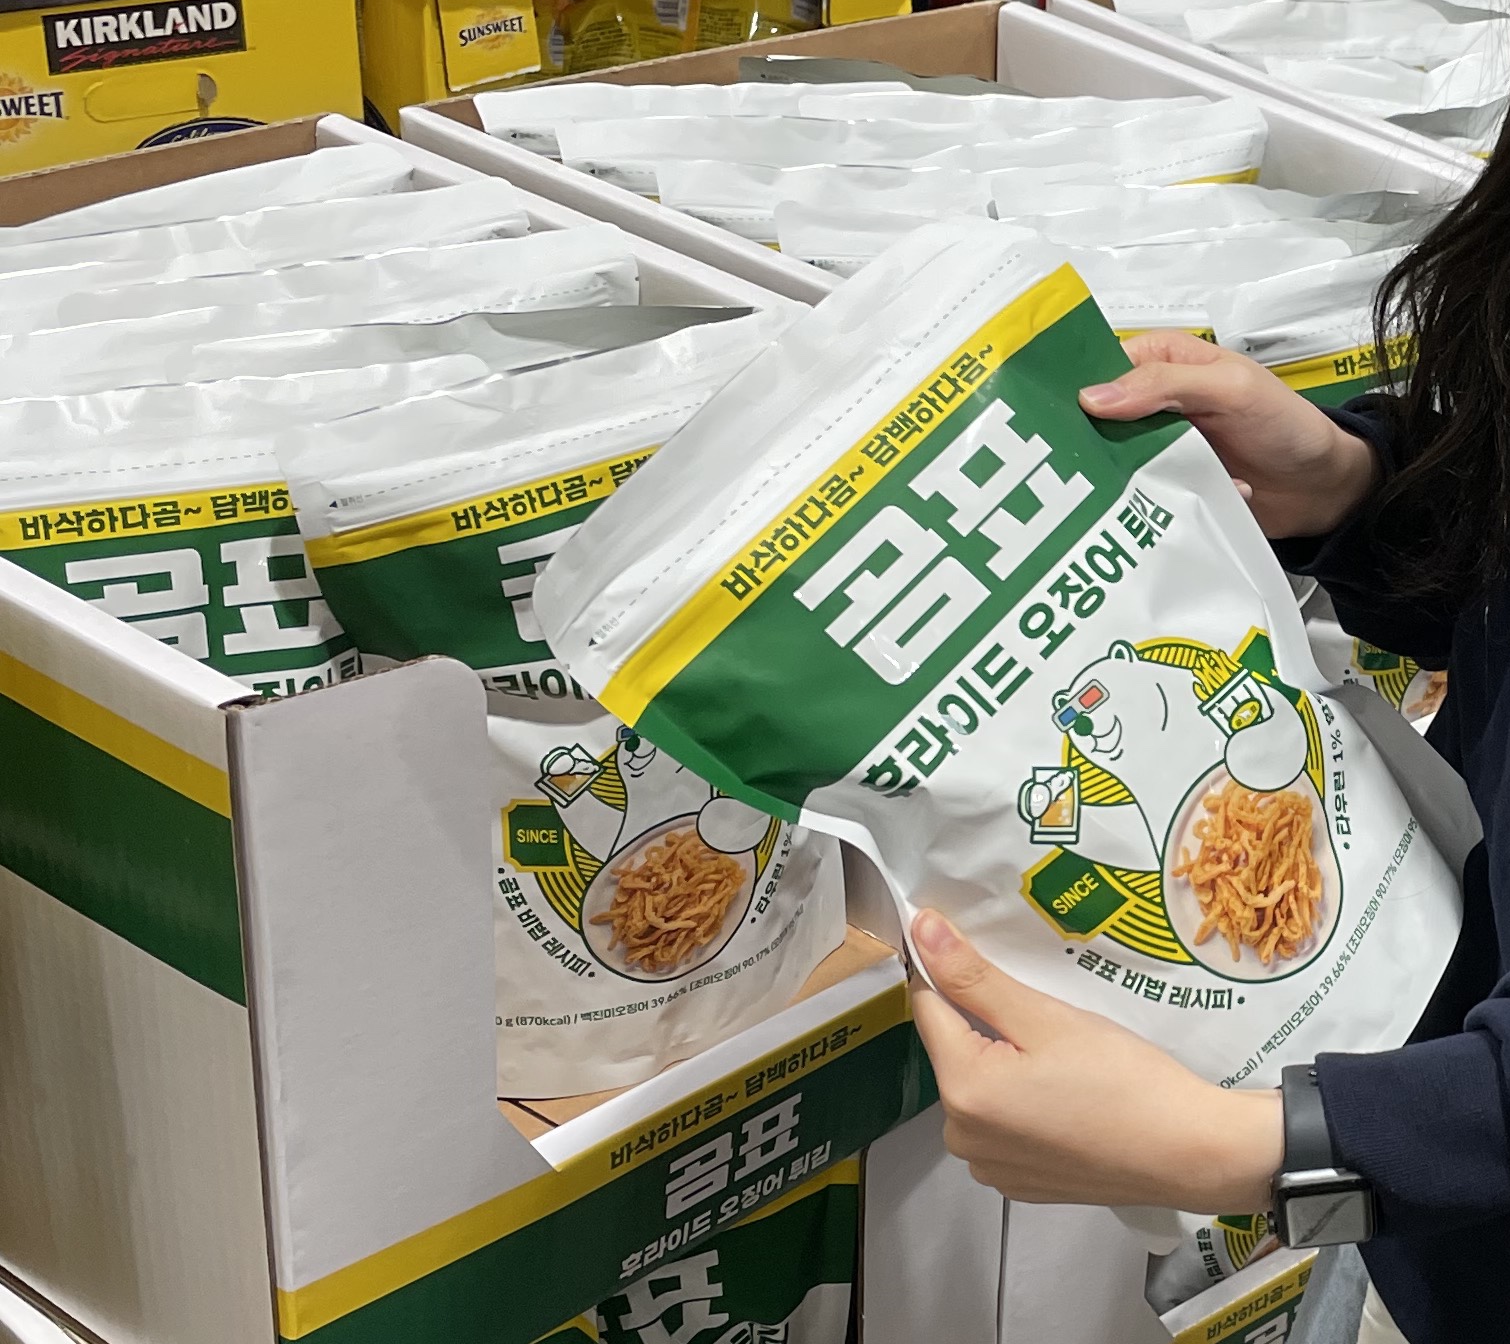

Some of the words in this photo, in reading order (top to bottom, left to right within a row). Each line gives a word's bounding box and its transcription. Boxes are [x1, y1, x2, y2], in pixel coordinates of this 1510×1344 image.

[55, 2, 237, 49] KIRKLAND
[459, 16, 525, 47] SUNSWEET
[451, 474, 603, 533] 바삭하다곰~
[720, 464, 866, 602] 바삭하다곰~
[860, 342, 996, 466] 담백하다곰~
[19, 497, 203, 543] 바삭하다곰~
[792, 396, 1096, 687] 곰표
[64, 534, 346, 660] 곰표
[1017, 527, 1139, 662] 오징어
[516, 827, 559, 844] SINCE
[1332, 770, 1353, 836] 타우린
[497, 876, 529, 914] 곰표
[516, 907, 552, 944] 비법
[541, 935, 592, 978] 레시피
[1051, 871, 1100, 918] SINCE
[1078, 947, 1121, 985] 곰표
[1120, 968, 1167, 1002] 비법
[1168, 983, 1233, 1012] 레시피
[1260, 988, 1325, 1057] 백진미오징어
[1318, 952, 1352, 997] 39.66%
[1375, 861, 1399, 901] 90.17%
[516, 1013, 571, 1027] (870kcal)
[580, 999, 650, 1023] 백진미오징어
[650, 986, 688, 1010] 39.66%
[609, 1088, 740, 1170] 바삭하다곰~
[744, 1022, 864, 1097] 담백하다곰~
[664, 1090, 804, 1220] 곰표
[618, 1207, 714, 1280] 후라이드
[716, 1167, 786, 1227] 오징어
[786, 1138, 834, 1182] 튀김
[1205, 1281, 1295, 1342] 바삭하다곰~
